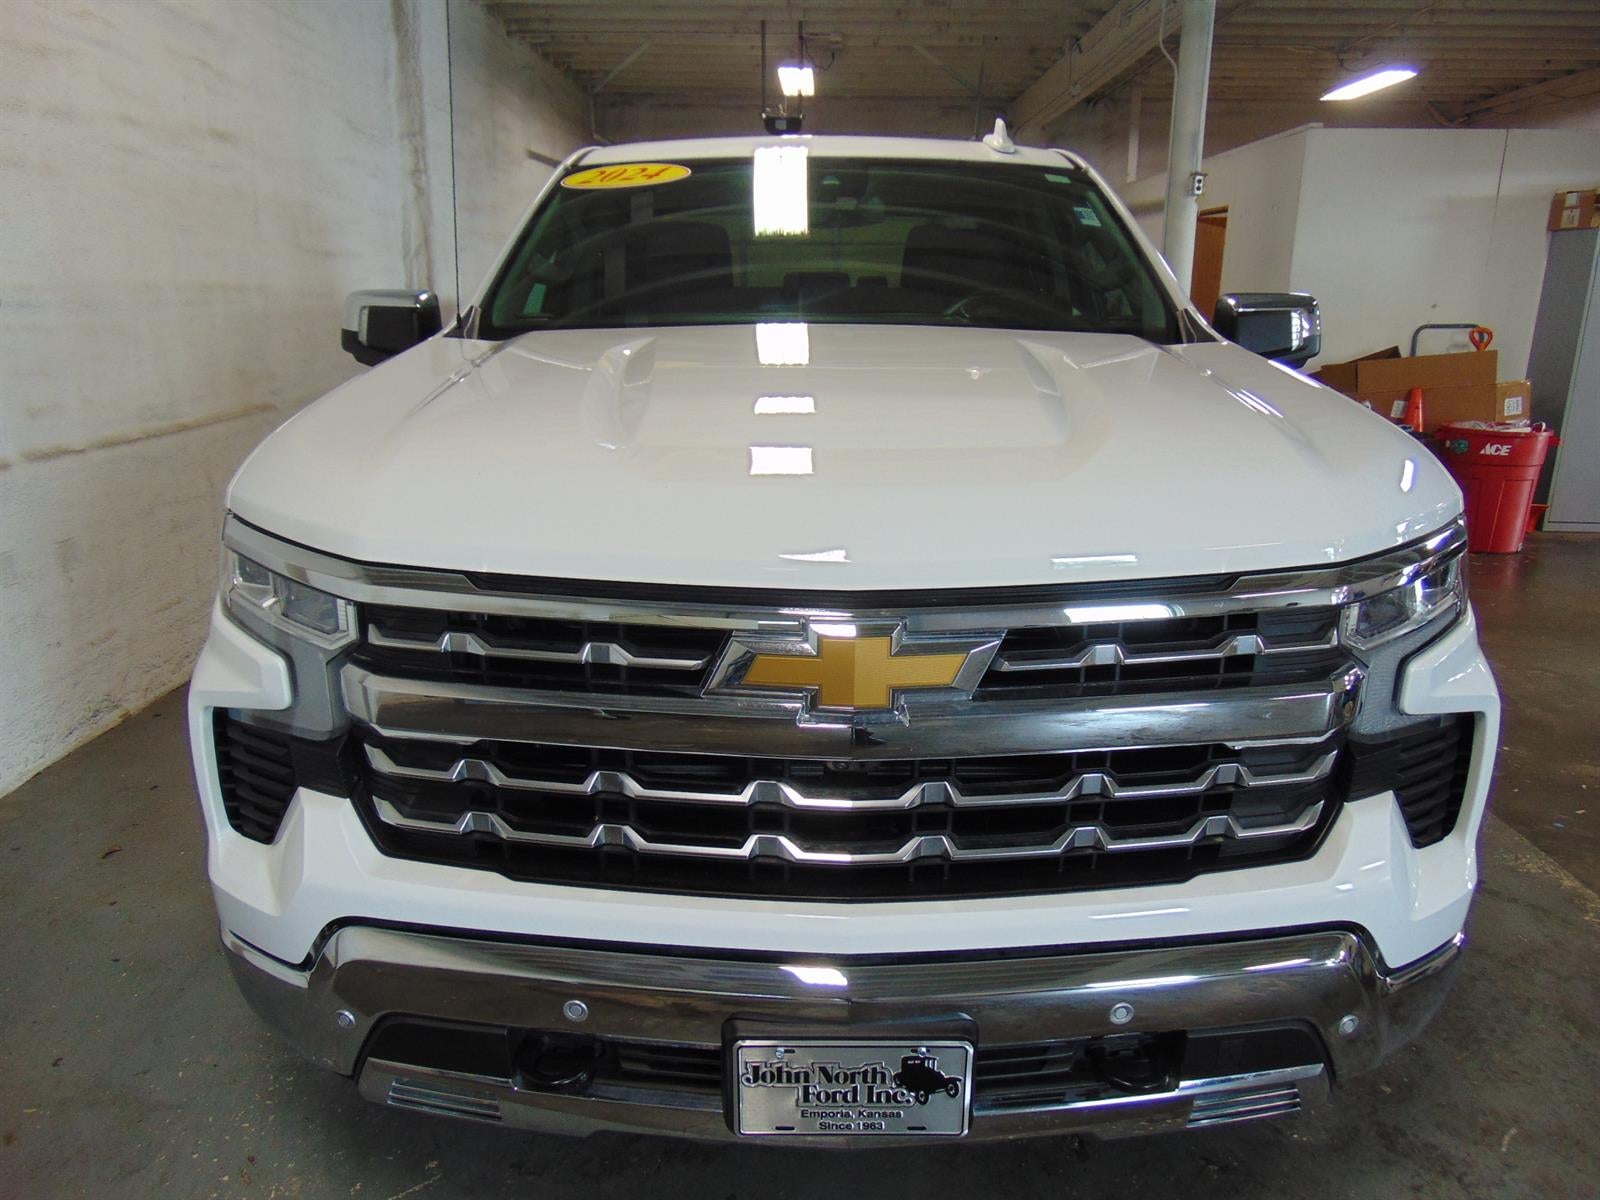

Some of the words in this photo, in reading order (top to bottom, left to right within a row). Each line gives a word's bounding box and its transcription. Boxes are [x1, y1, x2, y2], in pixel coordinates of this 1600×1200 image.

[577, 166, 671, 184] 2024
[1480, 443, 1512, 456] ACE
[745, 1065, 810, 1084] John
[818, 1066, 888, 1085] North
[801, 1085, 859, 1104] Ford
[866, 1085, 914, 1104] Inc.
[801, 1109, 854, 1120] Emporia,
[858, 1109, 903, 1118] Kansas
[819, 1121, 852, 1130] Since
[857, 1121, 884, 1130] 1963
